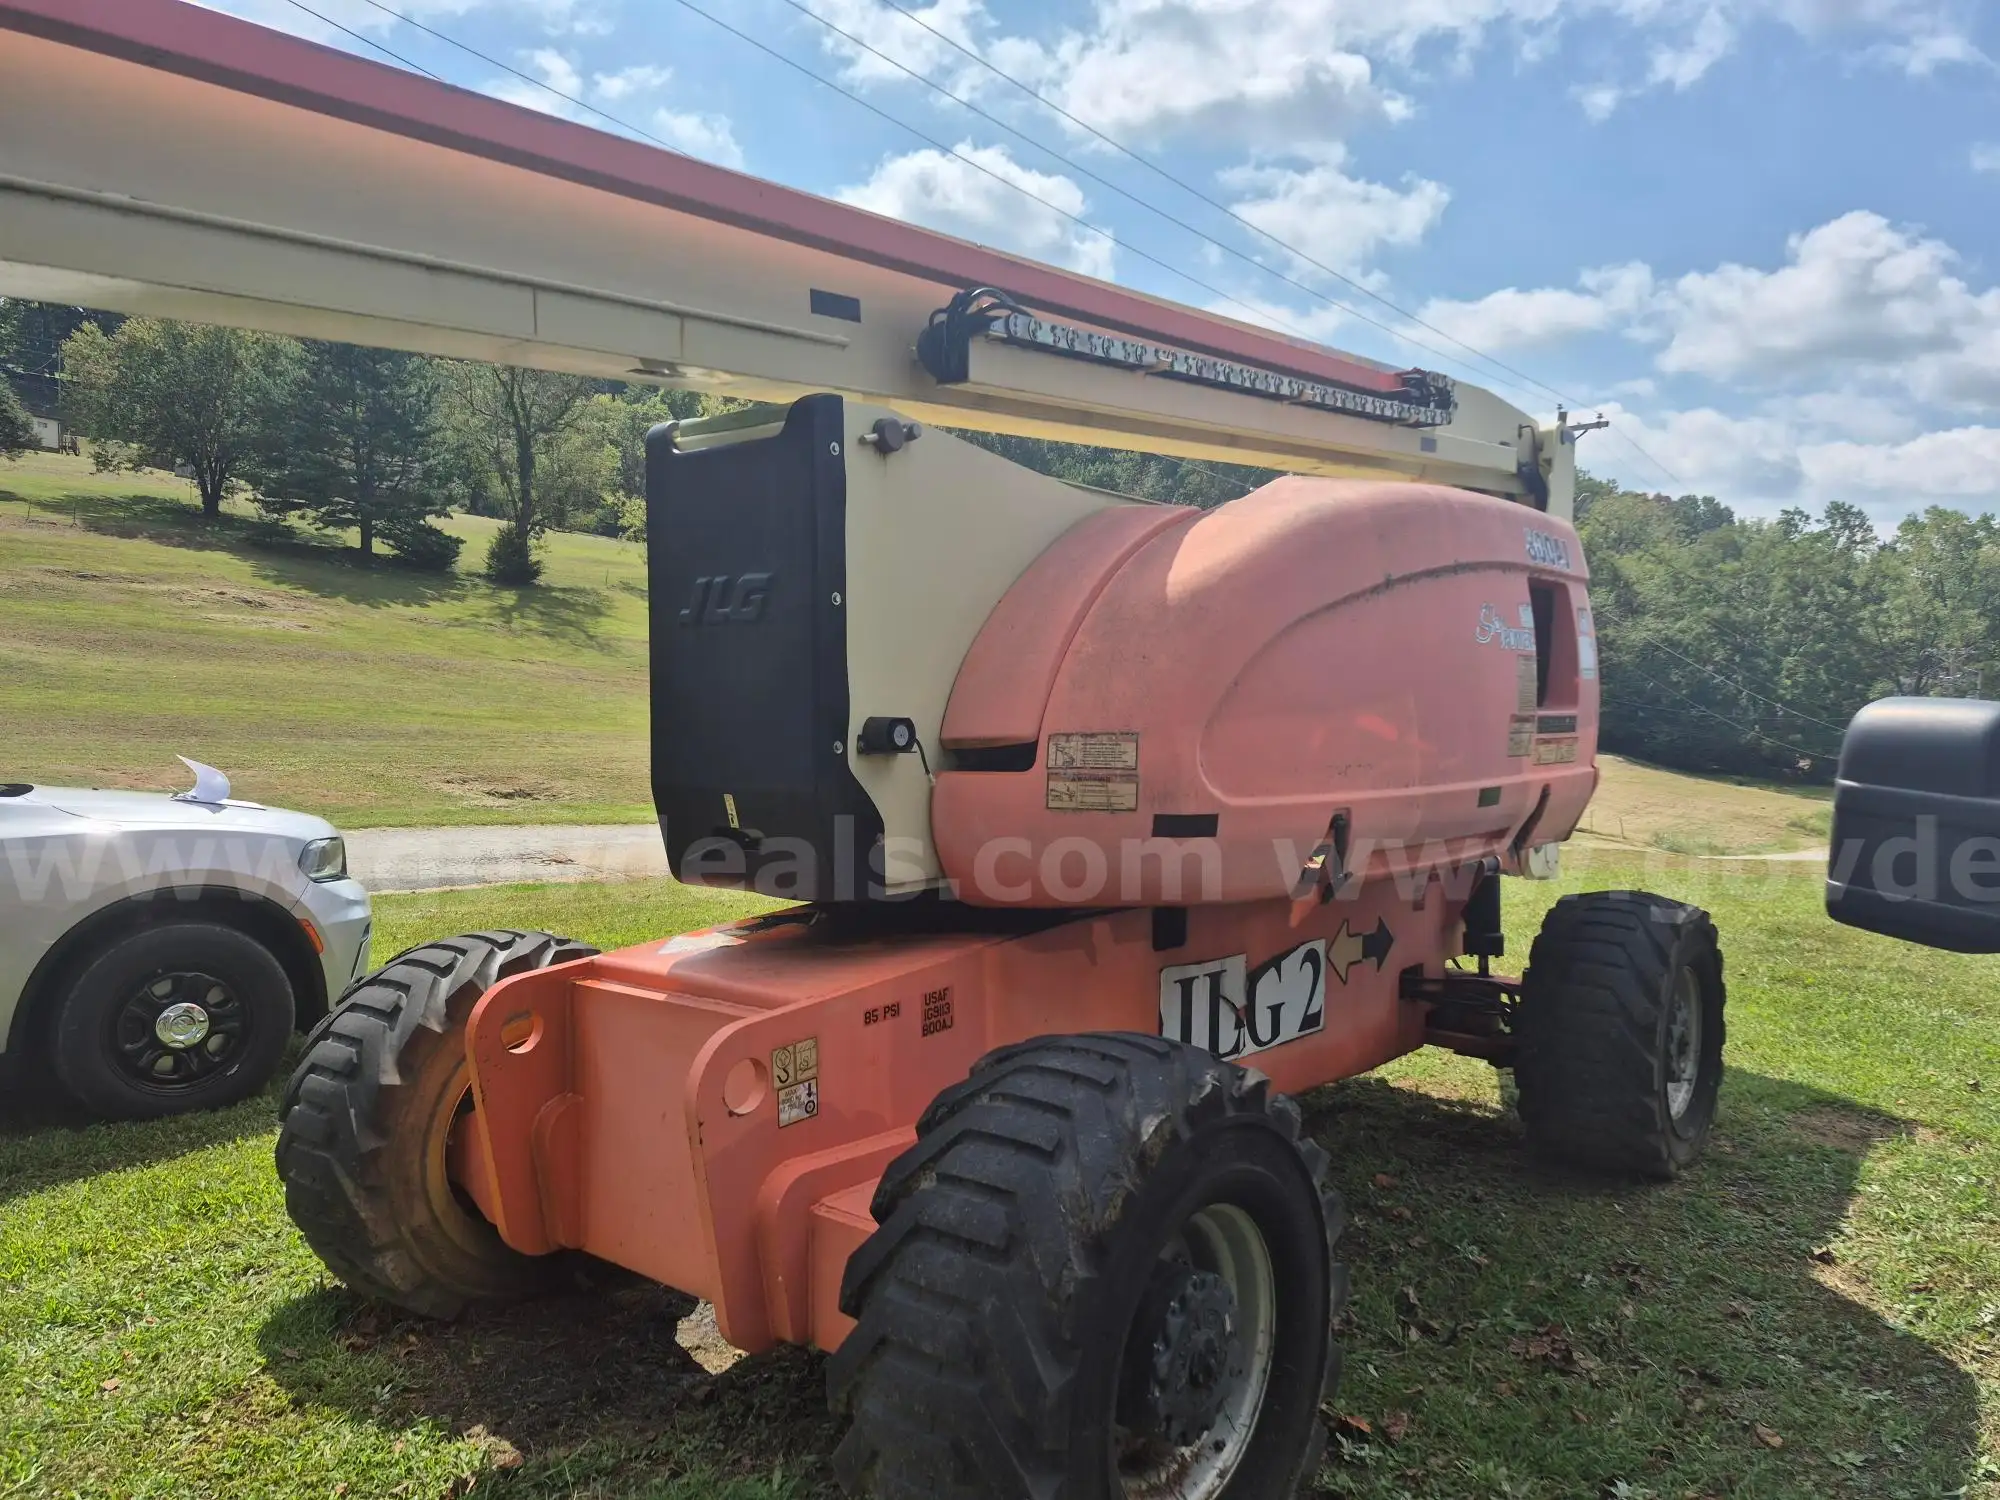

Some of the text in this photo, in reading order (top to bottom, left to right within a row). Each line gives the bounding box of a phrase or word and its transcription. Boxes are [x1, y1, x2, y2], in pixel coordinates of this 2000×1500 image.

[679, 572, 773, 627] JLG
[924, 987, 949, 1006] USAF
[864, 1002, 900, 1026] 85 PSI
